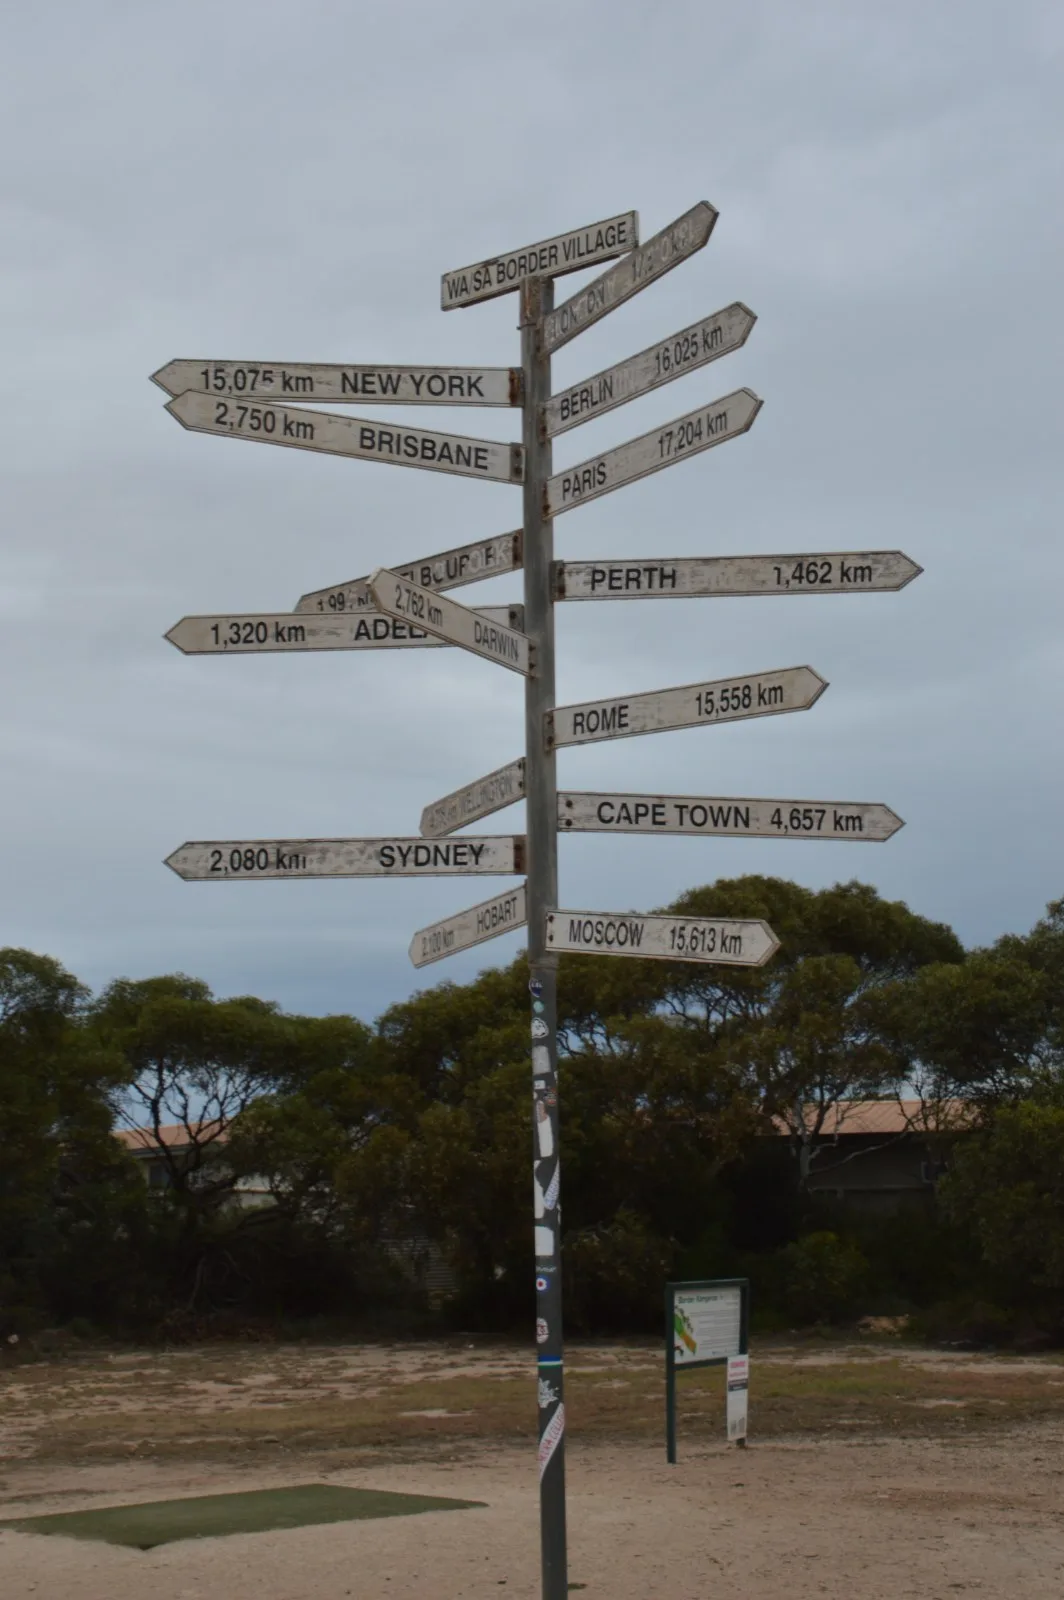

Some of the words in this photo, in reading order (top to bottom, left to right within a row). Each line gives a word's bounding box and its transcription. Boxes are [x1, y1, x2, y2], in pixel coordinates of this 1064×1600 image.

[496, 248, 559, 284] BORDER
[562, 220, 628, 262] VILLAGE
[281, 370, 315, 393] km
[340, 372, 402, 395] NEW
[409, 373, 486, 398] YORK
[559, 375, 614, 421] BERLIN
[654, 336, 699, 377] 16,025
[702, 325, 724, 352] km
[214, 401, 277, 433] 2,750
[282, 411, 315, 441] km
[359, 427, 489, 470] BRISBANE
[561, 461, 608, 502] PARIS
[657, 424, 703, 459] 17,204
[706, 410, 728, 437] km
[590, 566, 678, 592] PERTH
[772, 560, 833, 589] 1,462
[839, 560, 873, 584] km
[210, 621, 269, 650] 1,320
[273, 620, 306, 643] km
[395, 584, 425, 620] 2,762
[426, 602, 443, 628] km
[473, 619, 520, 662] DARWIN
[572, 704, 630, 736] ROME
[694, 683, 752, 718] 15,558
[756, 682, 784, 707] km
[596, 801, 667, 826] CAPE
[673, 803, 750, 829] TOWN
[769, 807, 827, 835] 4,657
[832, 809, 864, 832] km
[209, 848, 270, 875] 2,080
[378, 843, 486, 869] SYDNEY
[475, 896, 518, 933] HOBART
[568, 919, 645, 948] MOSCOW
[669, 926, 716, 953] 15,613
[719, 932, 743, 956] km
